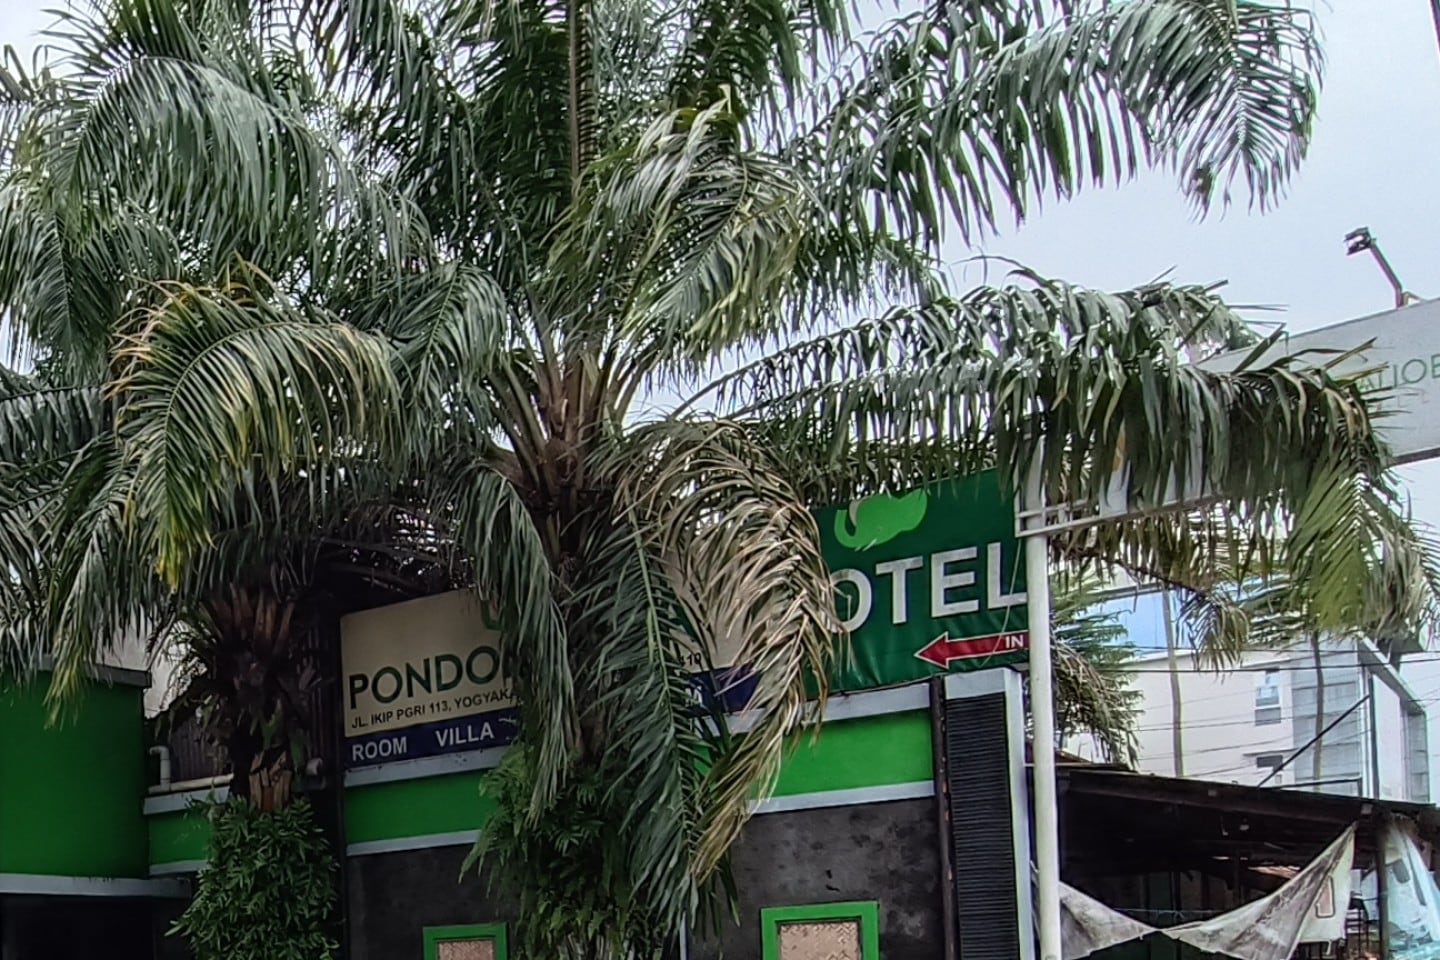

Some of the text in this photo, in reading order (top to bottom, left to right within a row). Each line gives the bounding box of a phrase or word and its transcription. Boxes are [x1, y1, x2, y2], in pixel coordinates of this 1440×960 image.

[823, 541, 1028, 634] OTEL
[1005, 634, 1024, 649] IN
[351, 717, 368, 729] JL.
[371, 710, 393, 725] IKIP
[396, 704, 426, 720] PGRI
[430, 700, 452, 715] 113,
[352, 721, 495, 762] ROOM VILLA
